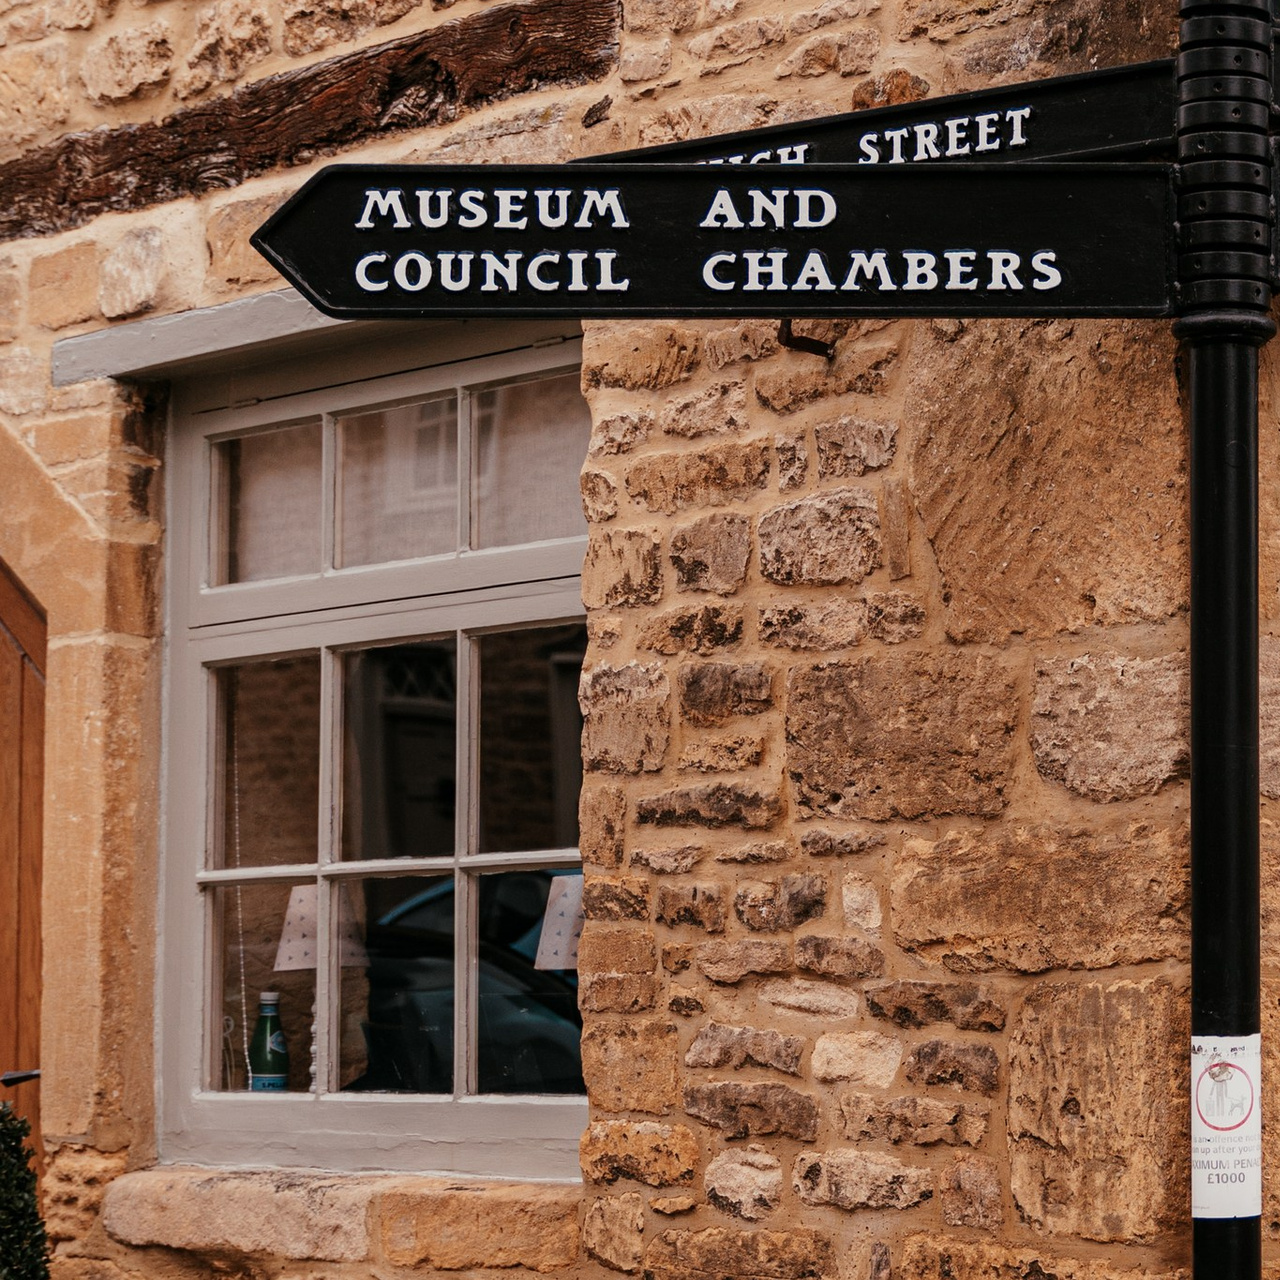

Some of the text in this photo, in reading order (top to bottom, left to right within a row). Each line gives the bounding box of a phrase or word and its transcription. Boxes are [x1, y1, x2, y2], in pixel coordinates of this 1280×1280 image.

[858, 107, 1031, 164] STREET
[354, 189, 837, 228] MUSEUM AND
[355, 252, 1062, 292] COUNCIL CHAMBERS
[1200, 1146, 1211, 1155] up
[1212, 1145, 1237, 1154] after
[1209, 1134, 1244, 1143] offence
[1207, 1172, 1246, 1184] £1000
